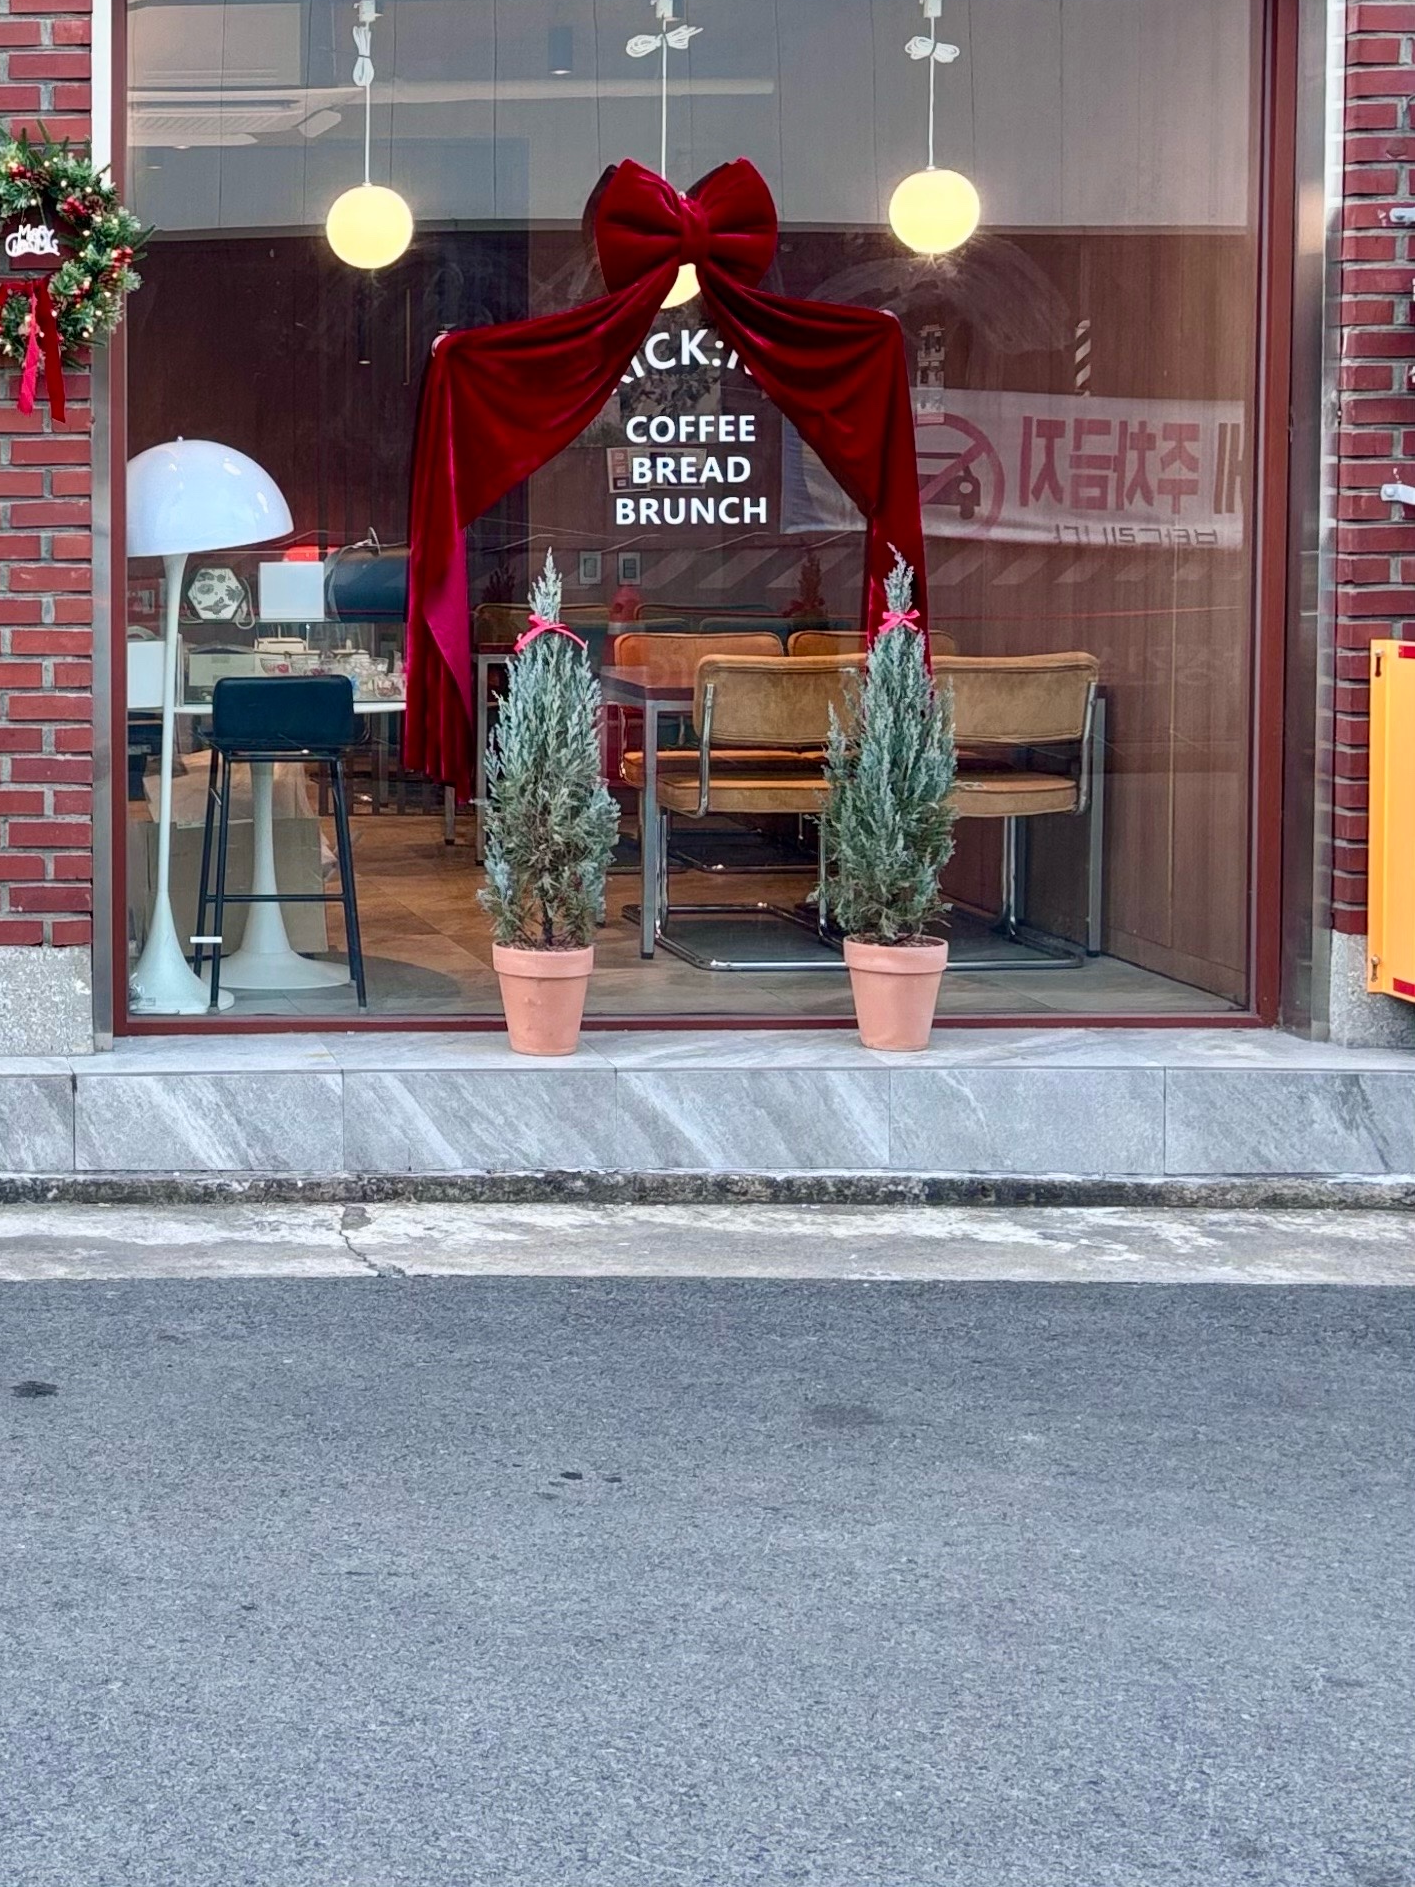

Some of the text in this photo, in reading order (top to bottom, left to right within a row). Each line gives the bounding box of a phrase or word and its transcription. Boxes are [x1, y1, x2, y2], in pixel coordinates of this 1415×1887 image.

[611, 329, 753, 395] ICK:
[626, 415, 756, 443] COFFEE
[632, 456, 751, 484] BREAD
[615, 497, 767, 525] BRUNCH
